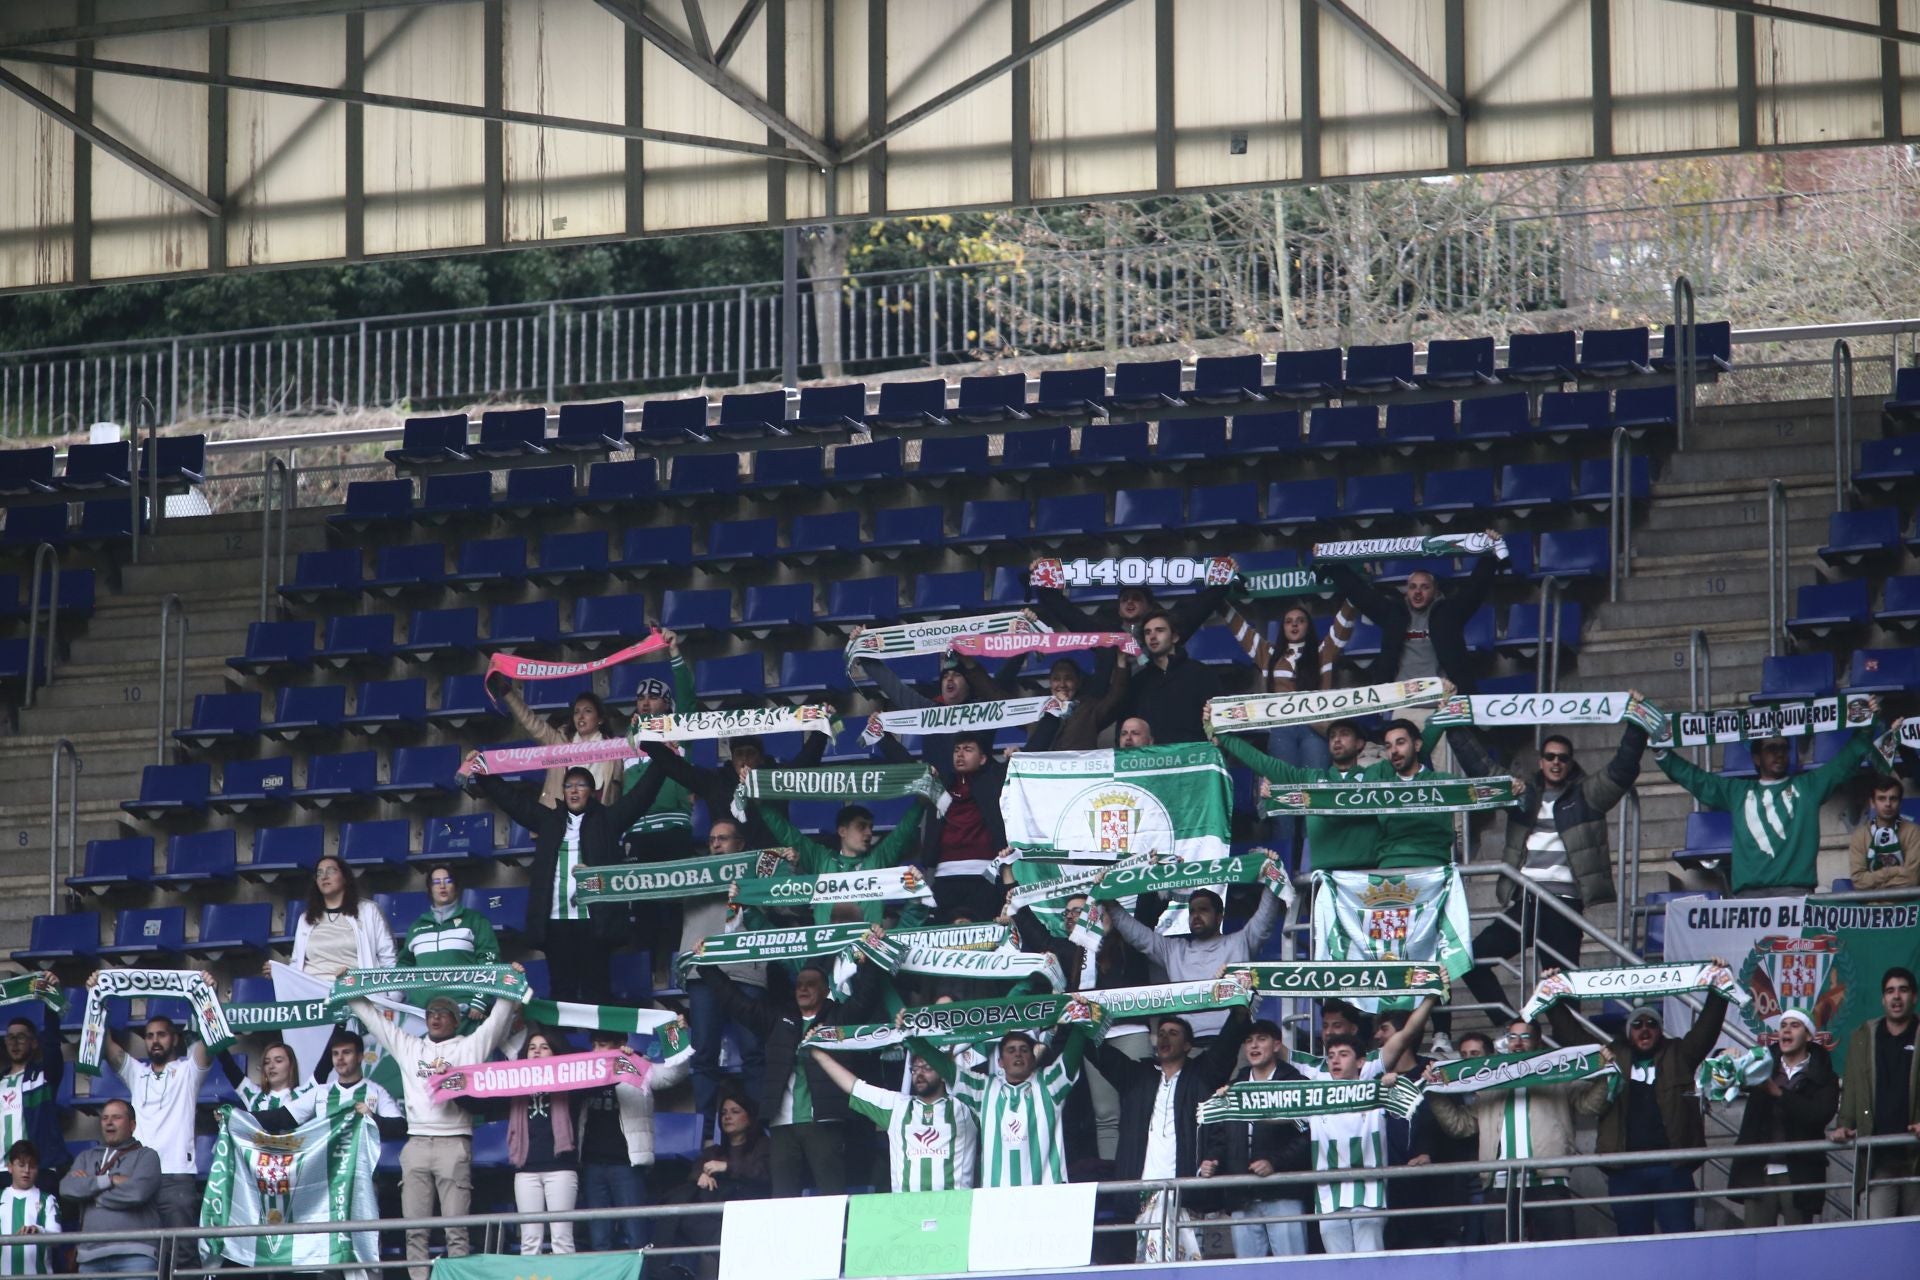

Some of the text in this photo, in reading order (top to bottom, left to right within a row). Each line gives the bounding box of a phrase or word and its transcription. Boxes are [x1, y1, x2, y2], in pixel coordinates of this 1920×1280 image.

[1776, 422, 1794, 437] 12
[1743, 506, 1757, 522] 11
[224, 536, 242, 551] 12
[1071, 557, 1196, 586] 14010
[1707, 577, 1726, 592] 10
[909, 622, 985, 638] CÓRDOBA CF
[1057, 634, 1099, 648] GIRLS
[516, 660, 588, 677] CÓRDOBA
[1674, 652, 1684, 667] 9
[123, 687, 141, 702] 10
[1266, 688, 1380, 717] CÓRDOBA
[921, 701, 1006, 728] VOLVEREMOS
[1486, 695, 1611, 717] CÓRDOBA
[1682, 704, 1837, 736] CALIFATO BLANQUIVERDE
[1084, 758, 1110, 771] 1954
[1121, 755, 1182, 770] CÓRDOBA
[861, 770, 886, 793] CF
[1335, 787, 1444, 806] CÓRDOBA
[18, 831, 29, 847] 8
[610, 863, 748, 892] CÓRDOBA CF
[770, 876, 882, 897] CÓRDOBA C.F.
[1688, 904, 1918, 933] CALIFATO BLANQUIVERDE
[736, 929, 836, 949] CÓRDOBA CF
[759, 945, 786, 956] DESDE
[1269, 967, 1387, 989] CÓRDOBA
[1588, 970, 1682, 988] CÓRDOBA
[1181, 984, 1212, 1006] C.F.
[305, 1002, 328, 1021] CF
[904, 1002, 1055, 1031] CÓRDOBA CF
[473, 1066, 555, 1092] CÓRDOBA
[558, 1058, 607, 1084] GIRLS
[1458, 1052, 1589, 1085] CÓRDOBA
